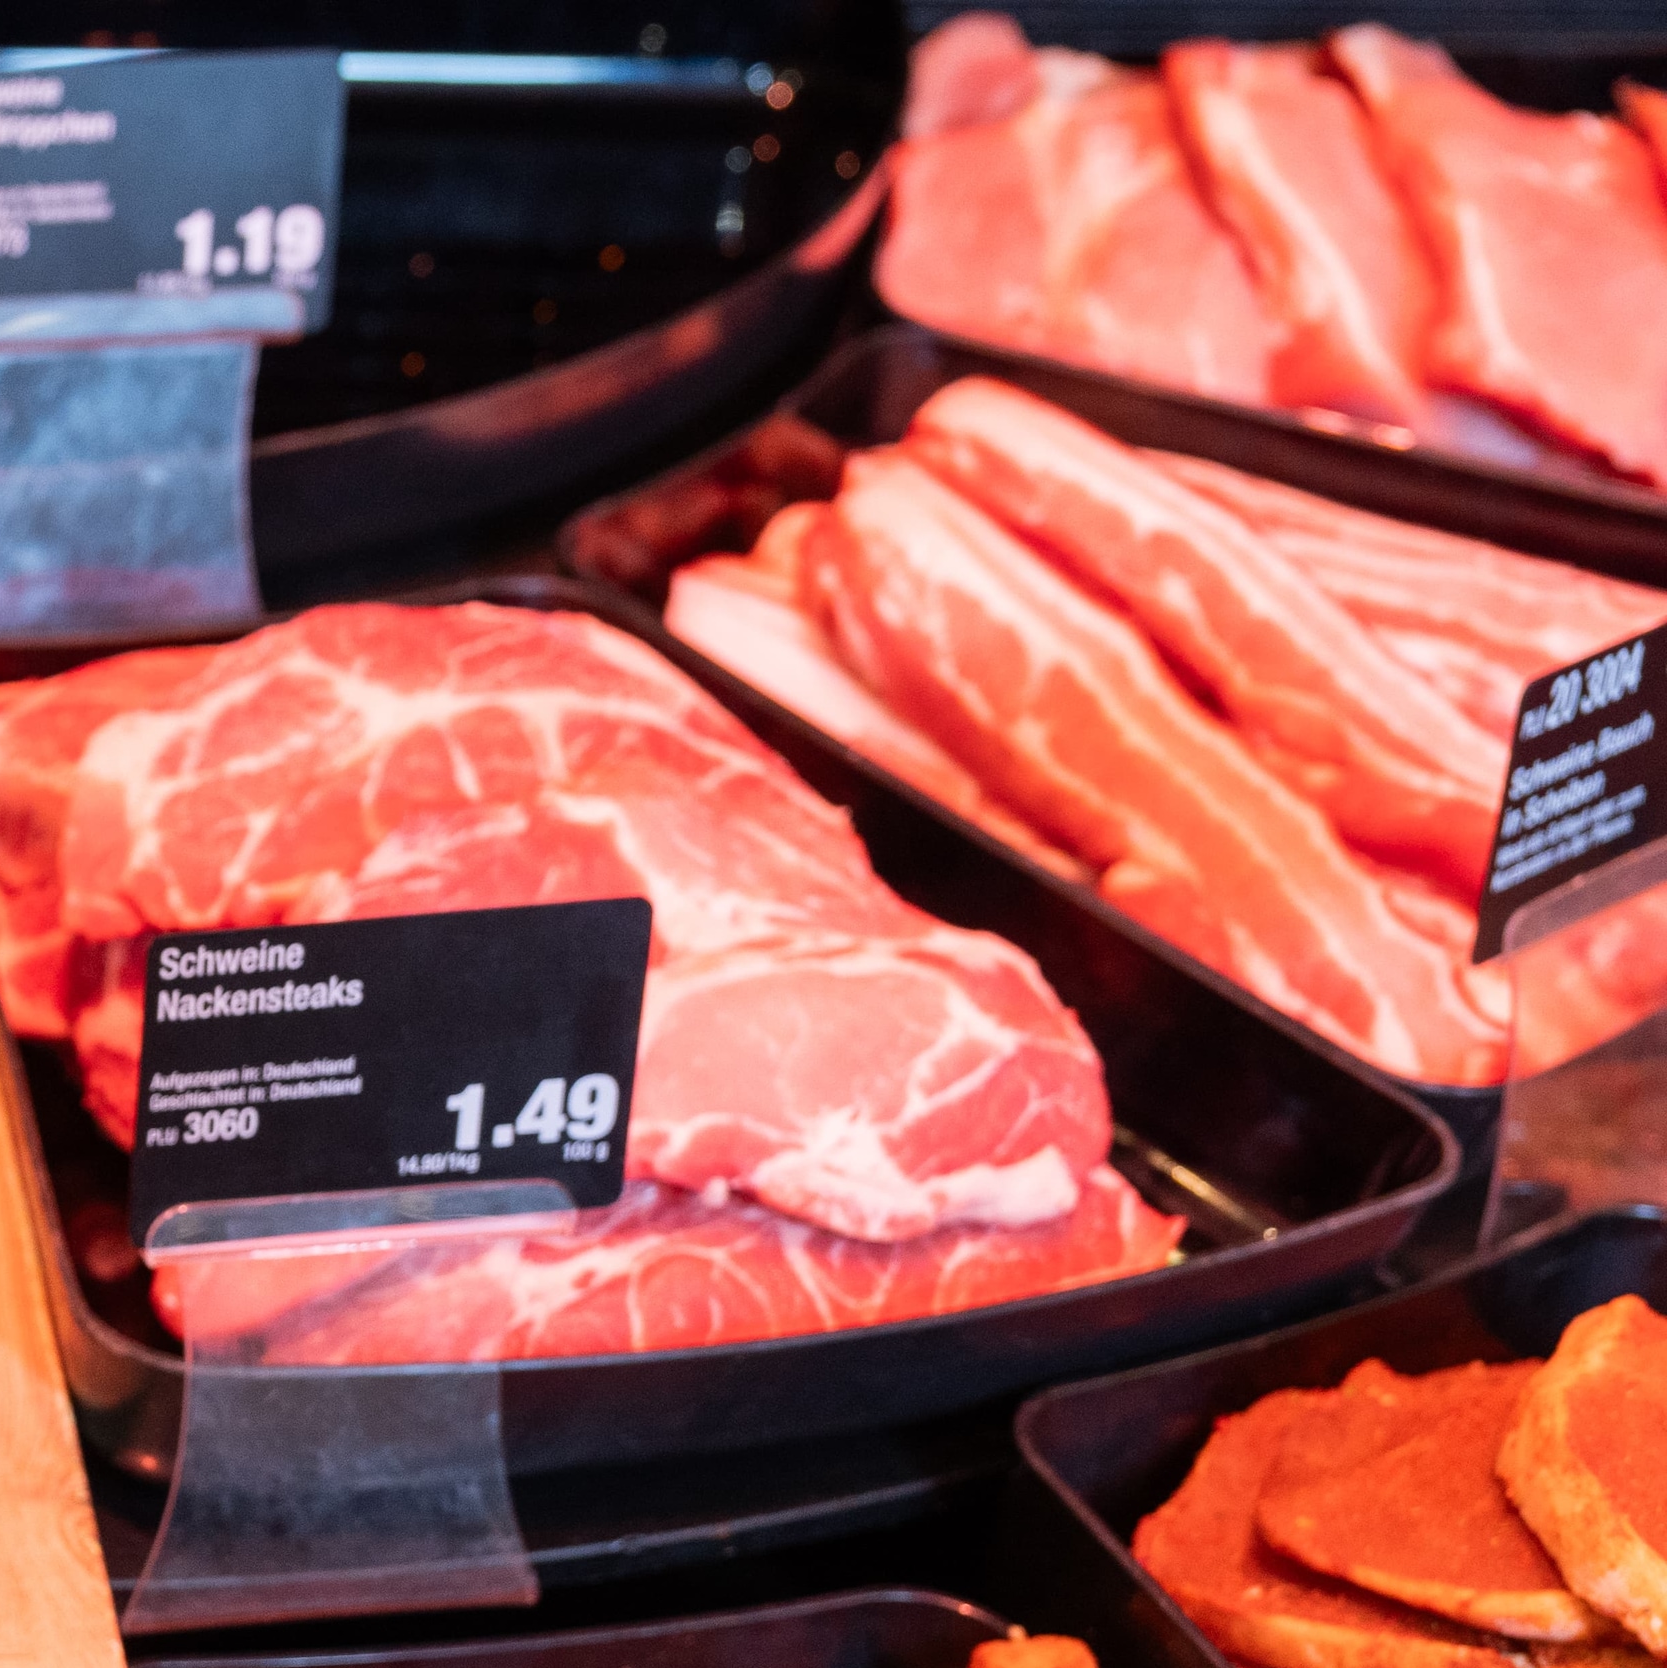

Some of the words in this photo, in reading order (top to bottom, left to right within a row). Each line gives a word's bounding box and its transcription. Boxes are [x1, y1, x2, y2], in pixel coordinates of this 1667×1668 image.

[175, 204, 326, 276] 1.19
[159, 939, 305, 981] Schweine
[156, 975, 364, 1022] Nackensteaks
[264, 1055, 357, 1082] Deutschland
[269, 1074, 363, 1101] Deutschland
[183, 1107, 259, 1144] 3060
[447, 1074, 619, 1151] 1.49
